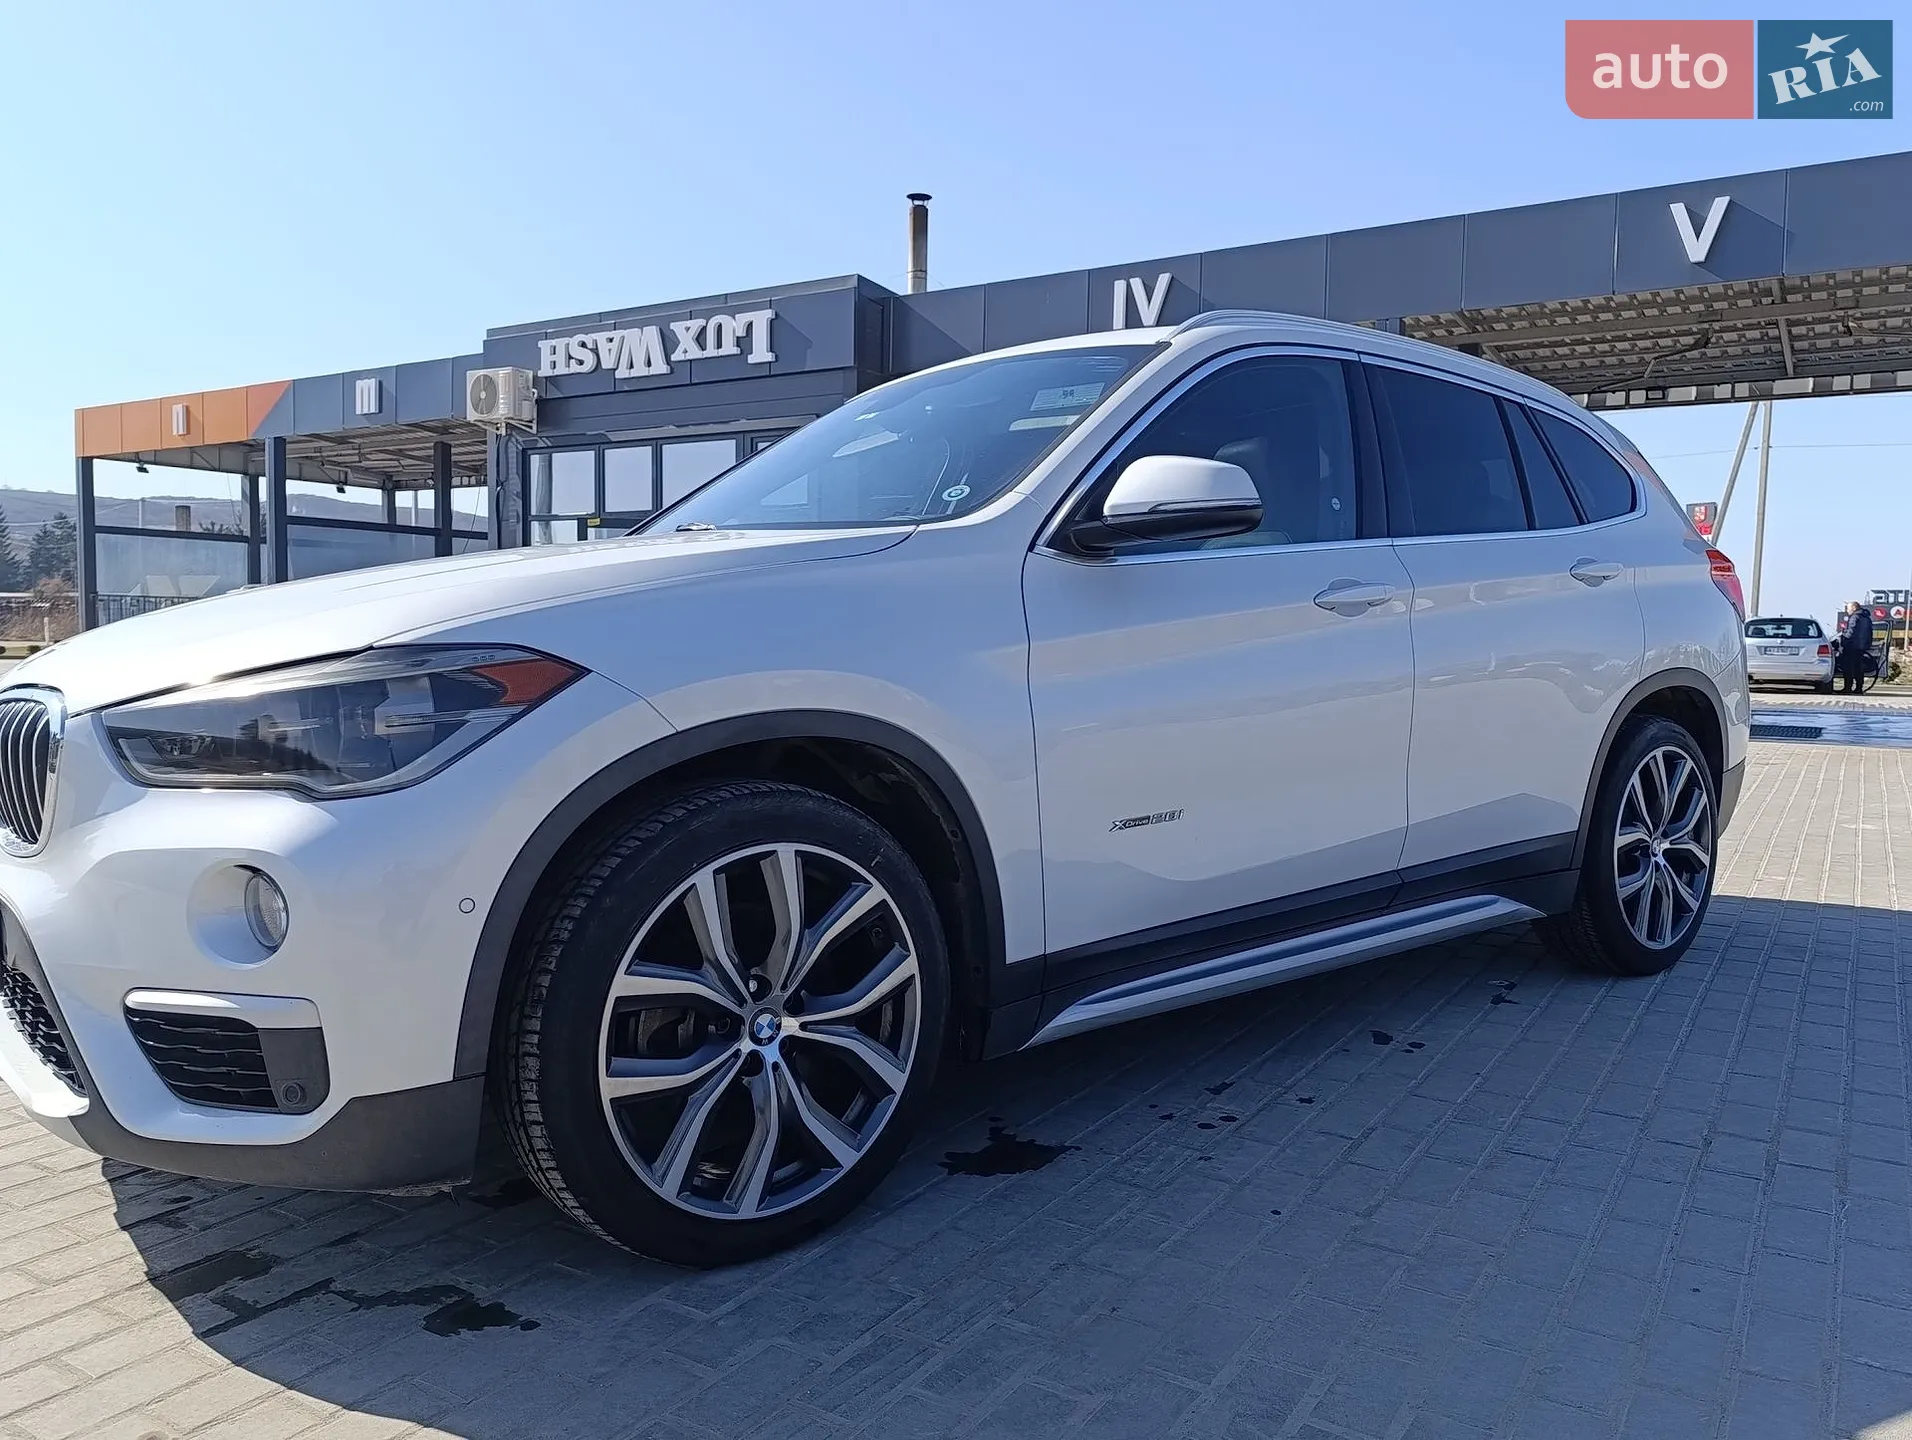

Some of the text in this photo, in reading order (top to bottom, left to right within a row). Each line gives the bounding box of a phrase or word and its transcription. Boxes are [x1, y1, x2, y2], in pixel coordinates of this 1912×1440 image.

[1669, 196, 1730, 264] V
[1113, 272, 1173, 331] IV
[537, 308, 777, 380] LUX WASH
